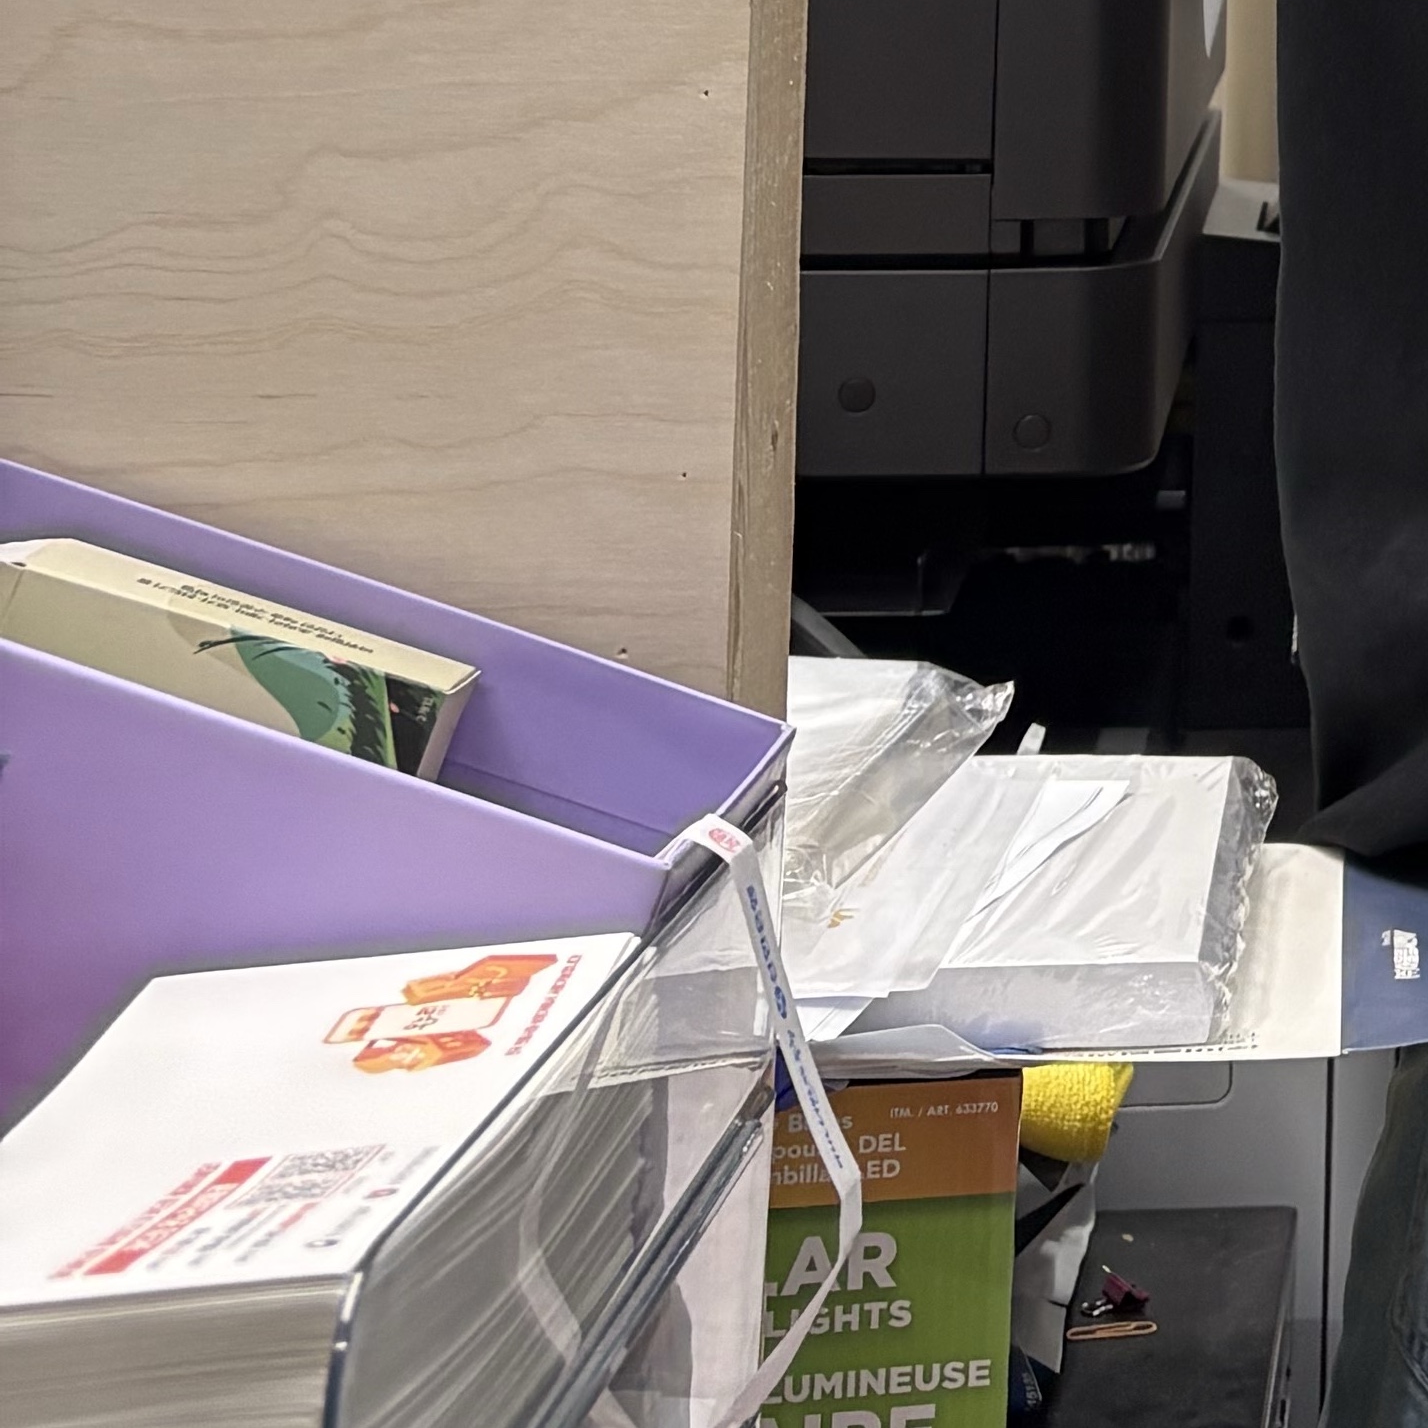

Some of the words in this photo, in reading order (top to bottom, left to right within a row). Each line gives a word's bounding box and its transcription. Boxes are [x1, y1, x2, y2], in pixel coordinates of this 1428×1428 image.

[955, 1101, 999, 1115] 633770
[858, 1132, 907, 1154] DEL
[861, 1159, 901, 1179] ED
[765, 1231, 898, 1297] AR
